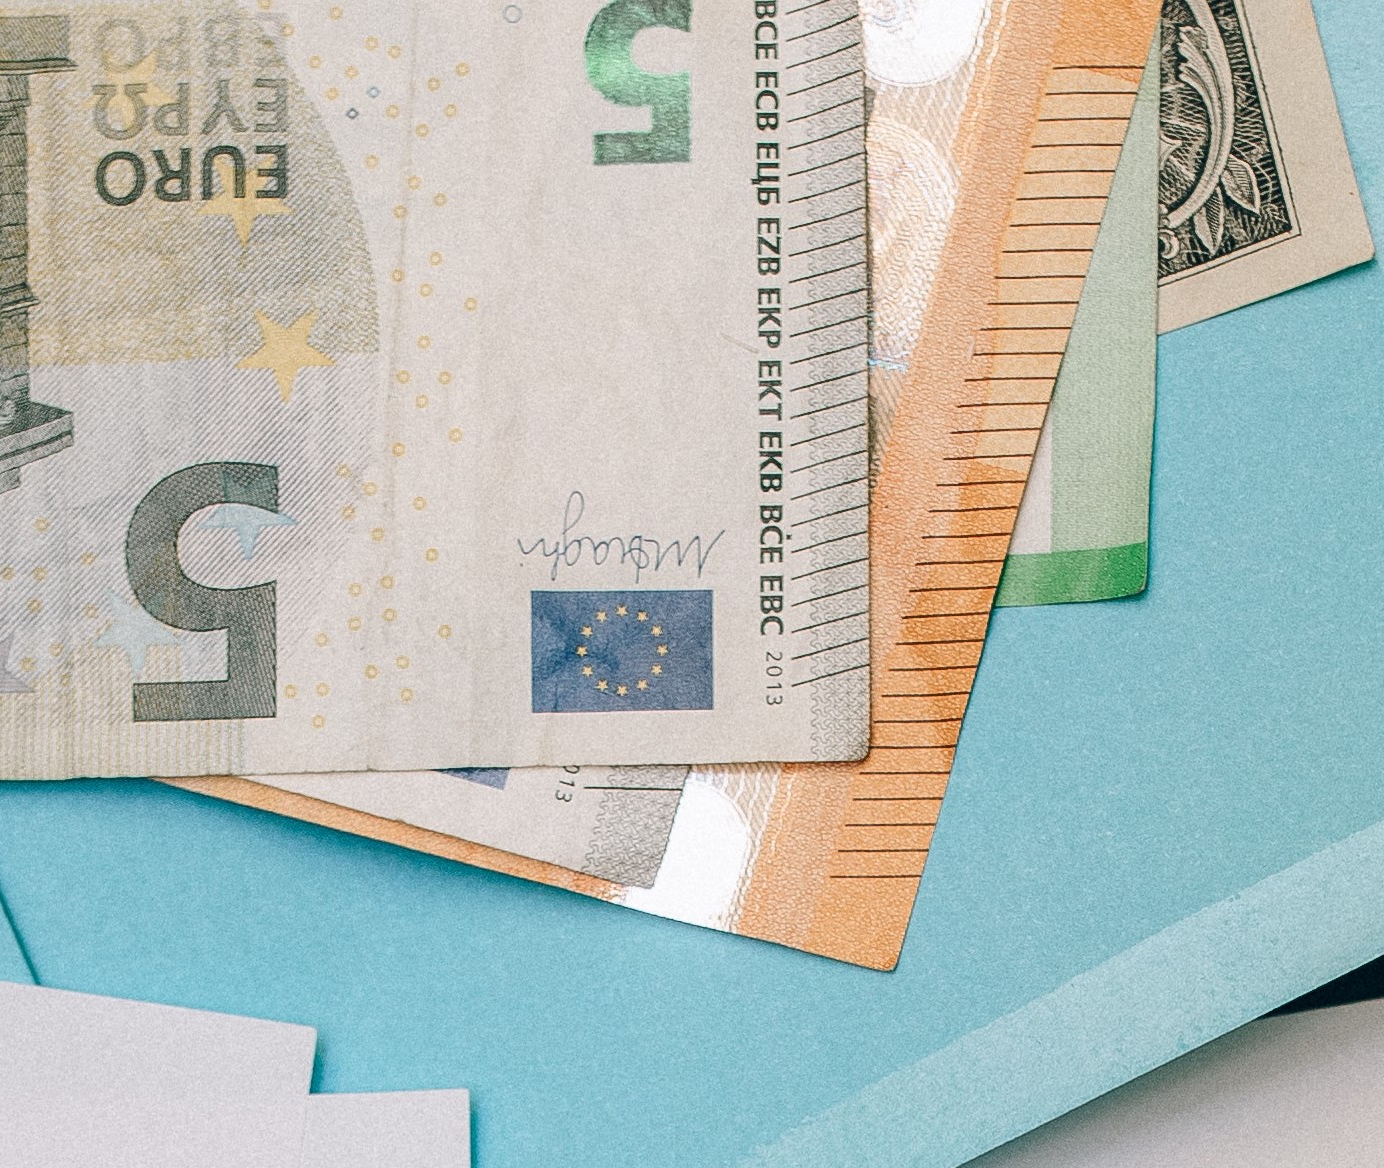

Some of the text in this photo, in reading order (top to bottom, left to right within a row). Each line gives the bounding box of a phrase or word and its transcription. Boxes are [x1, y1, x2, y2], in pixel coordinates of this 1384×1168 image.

[754, 0, 779, 60] BCE
[583, 0, 692, 166] 5
[754, 71, 780, 132] ECB
[95, 145, 288, 206] EURO
[757, 217, 782, 276] EZB
[757, 287, 782, 349] EKP
[758, 359, 783, 422] EKT
[759, 431, 783, 493] EKB
[126, 461, 279, 721] 5
[759, 574, 785, 636] EBC
[765, 651, 784, 707] 2013
[555, 765, 580, 802] 013
